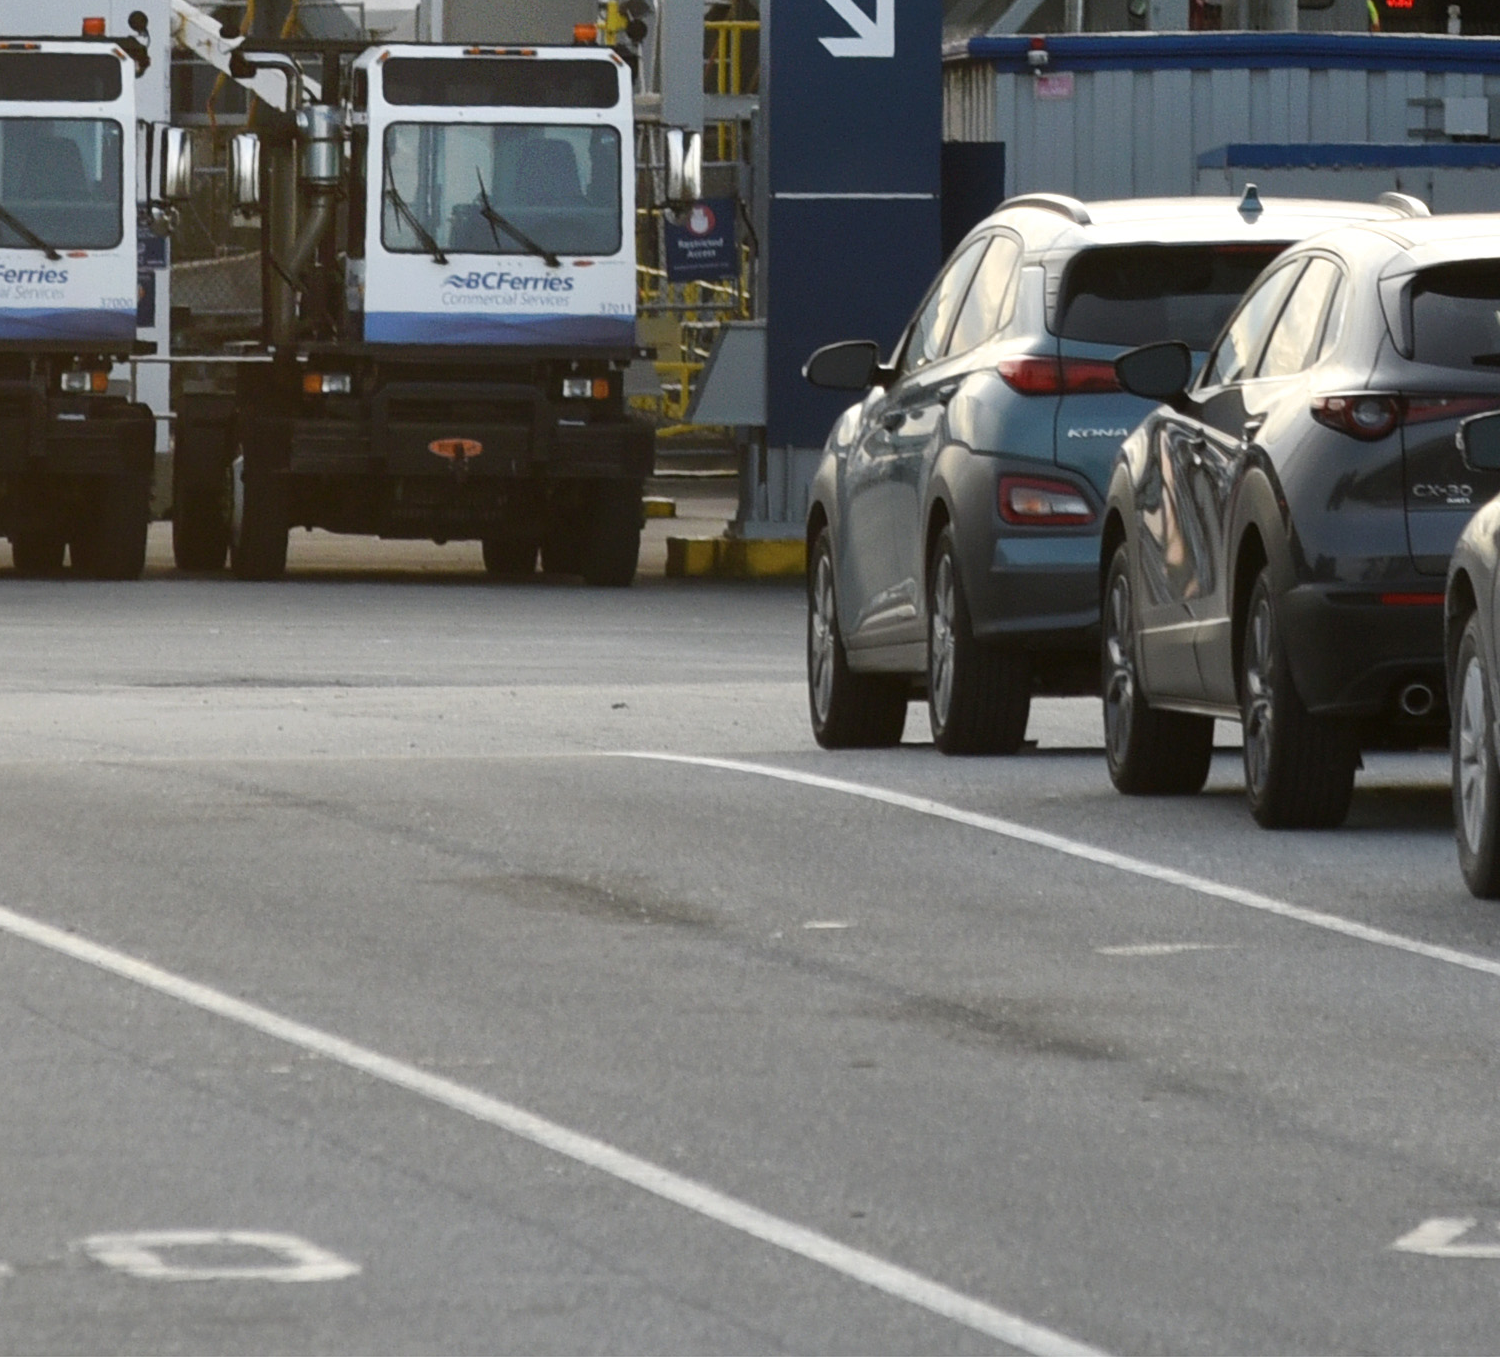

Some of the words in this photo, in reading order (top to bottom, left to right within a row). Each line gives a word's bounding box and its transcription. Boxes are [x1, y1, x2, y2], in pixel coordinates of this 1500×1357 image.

[466, 271, 575, 291] BCFerries
[15, 285, 65, 300] Services
[441, 291, 517, 306] Commercial
[520, 292, 570, 306] Services
[1067, 428, 1128, 438] KONA
[1412, 484, 1473, 497] CX-30
